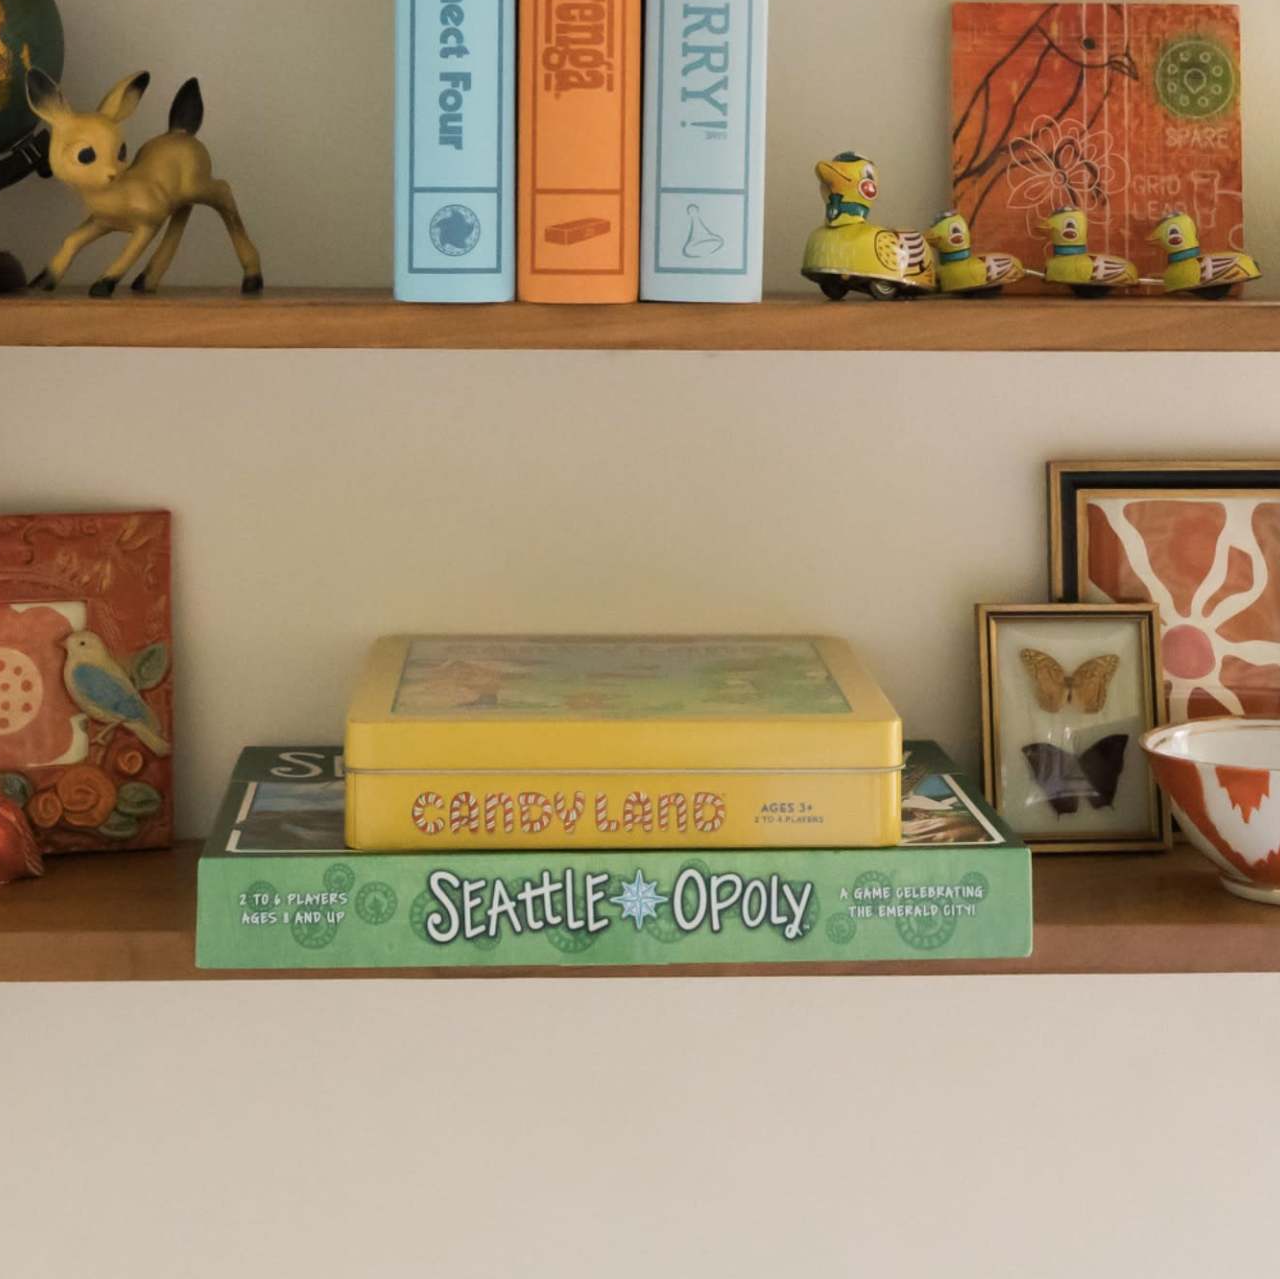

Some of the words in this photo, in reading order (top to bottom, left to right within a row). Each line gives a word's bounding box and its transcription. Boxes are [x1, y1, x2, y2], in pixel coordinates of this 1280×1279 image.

[438, 72, 472, 150] Four
[1166, 127, 1229, 149] SPARE
[1132, 174, 1181, 196] GRID
[412, 791, 587, 835] CANDY
[594, 791, 726, 834] LAND
[761, 802, 795, 814] AGES
[799, 802, 813, 814] 3+
[239, 893, 247, 905] 2
[253, 893, 269, 905] TO
[274, 893, 281, 905] 6
[287, 892, 348, 905] PLAYERS
[839, 887, 848, 900] A
[854, 887, 891, 900] GAME
[896, 885, 984, 899] CELEBRATING
[672, 868, 813, 940] OPOLY
[848, 905, 873, 918] THE
[878, 904, 939, 918] EMERALD
[943, 904, 976, 916] CITY!
[242, 912, 277, 925] AGES
[294, 912, 321, 925] AND
[326, 911, 345, 924] UP
